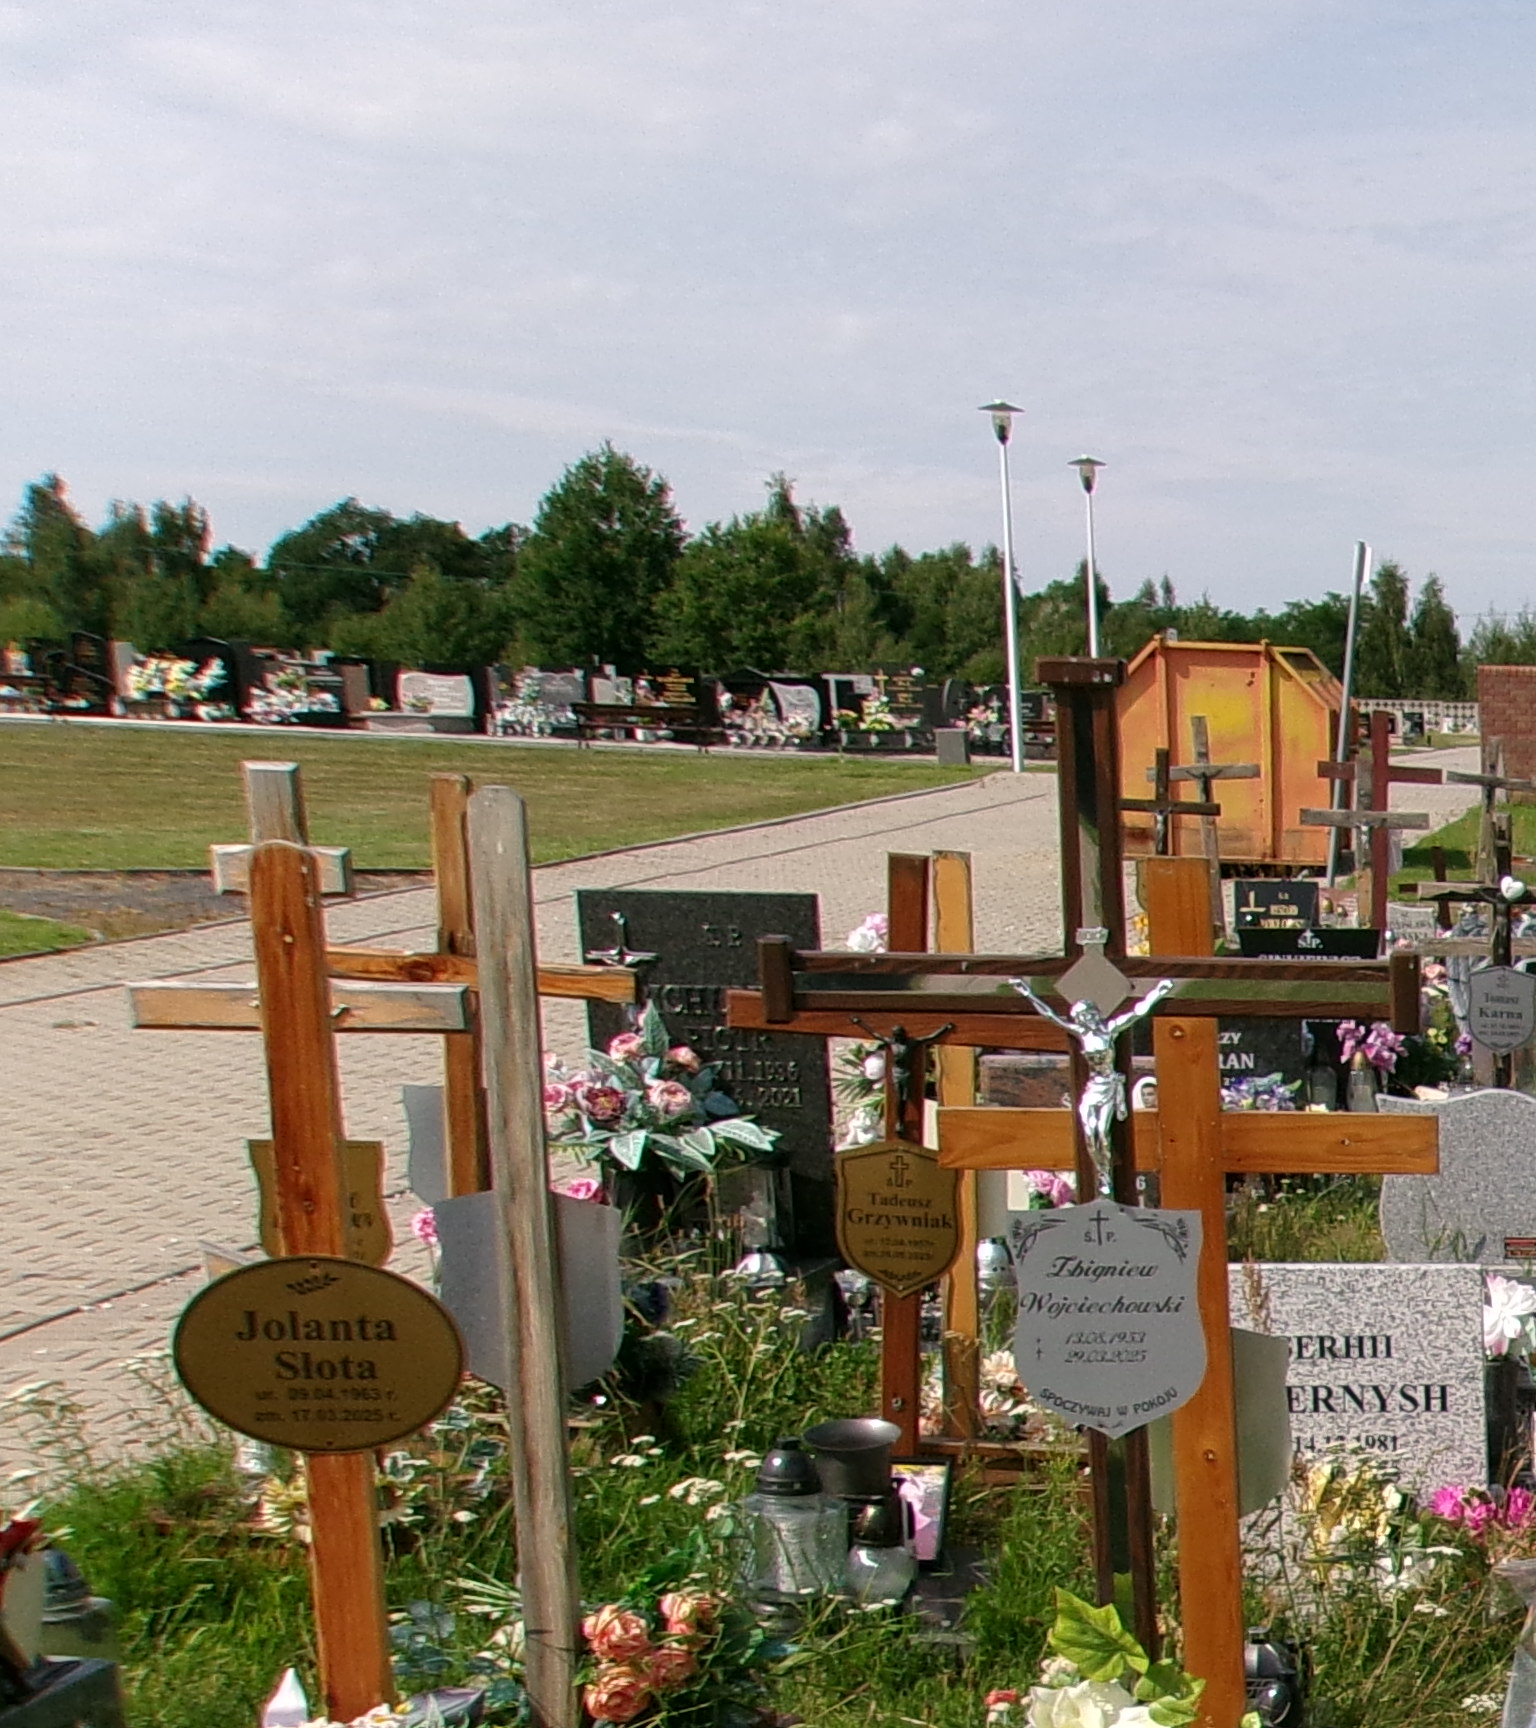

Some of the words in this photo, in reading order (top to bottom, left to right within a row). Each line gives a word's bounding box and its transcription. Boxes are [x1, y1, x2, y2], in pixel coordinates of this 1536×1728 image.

[847, 1208, 953, 1229] Grzywniak
[1046, 1255, 1160, 1282] Zbigniew
[1020, 1292, 1186, 1319] Wojciechowski
[235, 1310, 397, 1341] Jolanta
[1289, 1334, 1392, 1359] ERHII
[1039, 1387, 1112, 1417] SPOCZYWAJ
[1117, 1405, 1129, 1416] W
[1132, 1386, 1178, 1414] POKOJU
[1286, 1384, 1450, 1413] ERNYSH
